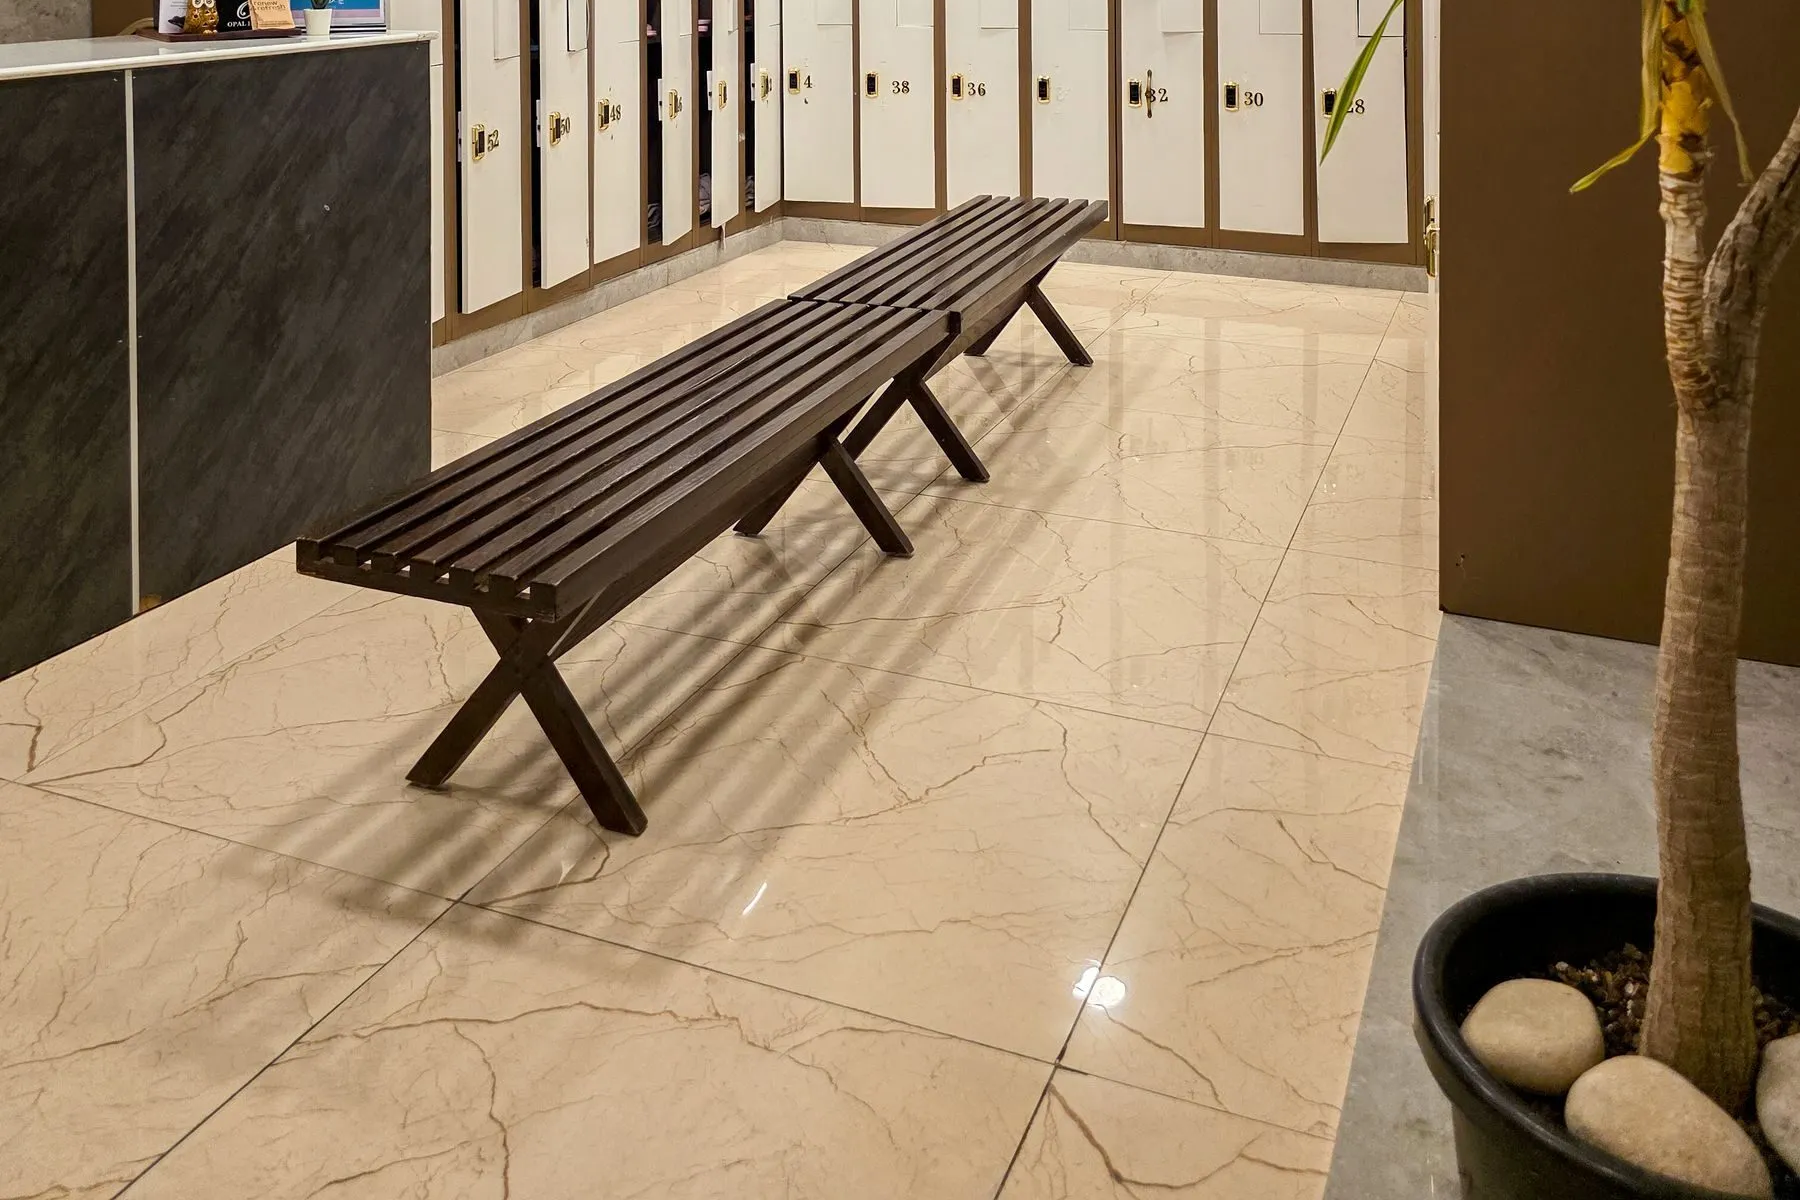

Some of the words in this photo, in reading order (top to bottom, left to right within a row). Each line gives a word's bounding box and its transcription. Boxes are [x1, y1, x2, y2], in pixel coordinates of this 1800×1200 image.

[803, 75, 813, 89] 4
[891, 80, 910, 94] 38
[967, 82, 987, 97] 36
[1148, 88, 1169, 103] 32
[1244, 91, 1264, 107] 30
[609, 105, 622, 121] 48
[559, 116, 571, 136] 50
[487, 130, 500, 152] 52
